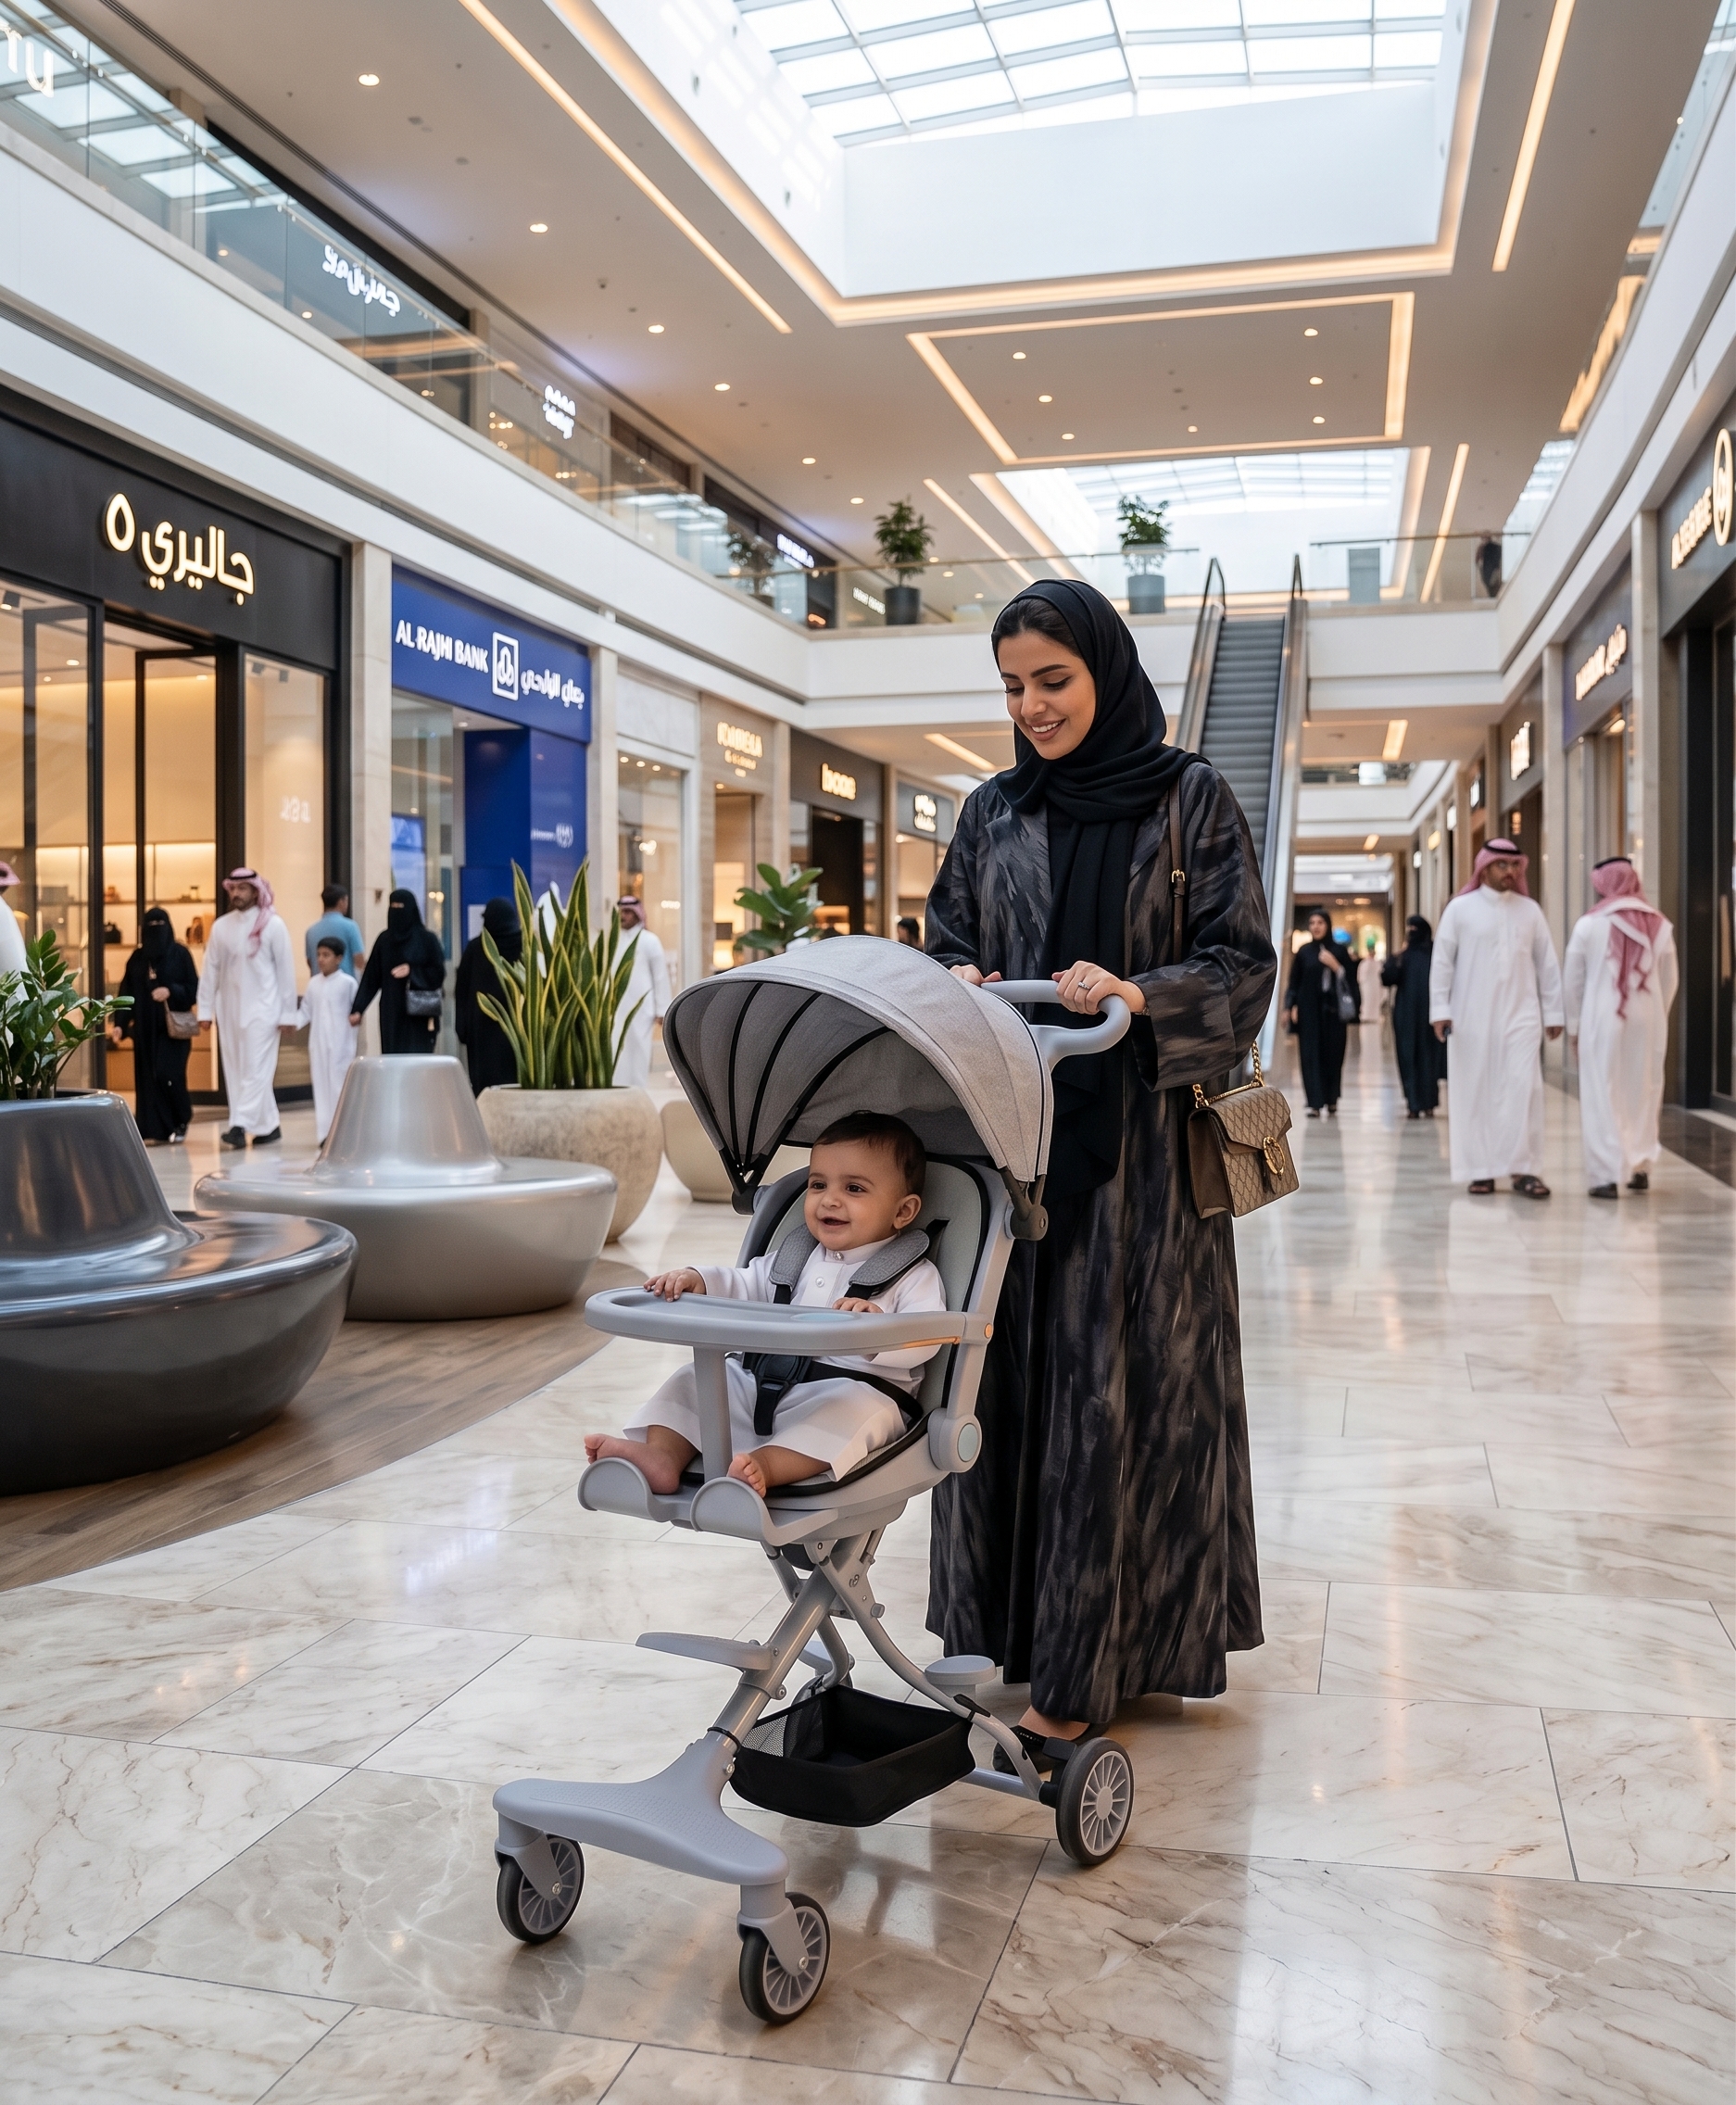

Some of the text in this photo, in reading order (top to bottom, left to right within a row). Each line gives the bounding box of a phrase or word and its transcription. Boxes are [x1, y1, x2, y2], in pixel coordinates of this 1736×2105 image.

[142, 521, 254, 606] جاليري
[396, 620, 488, 673] AL RAJHI BANK
